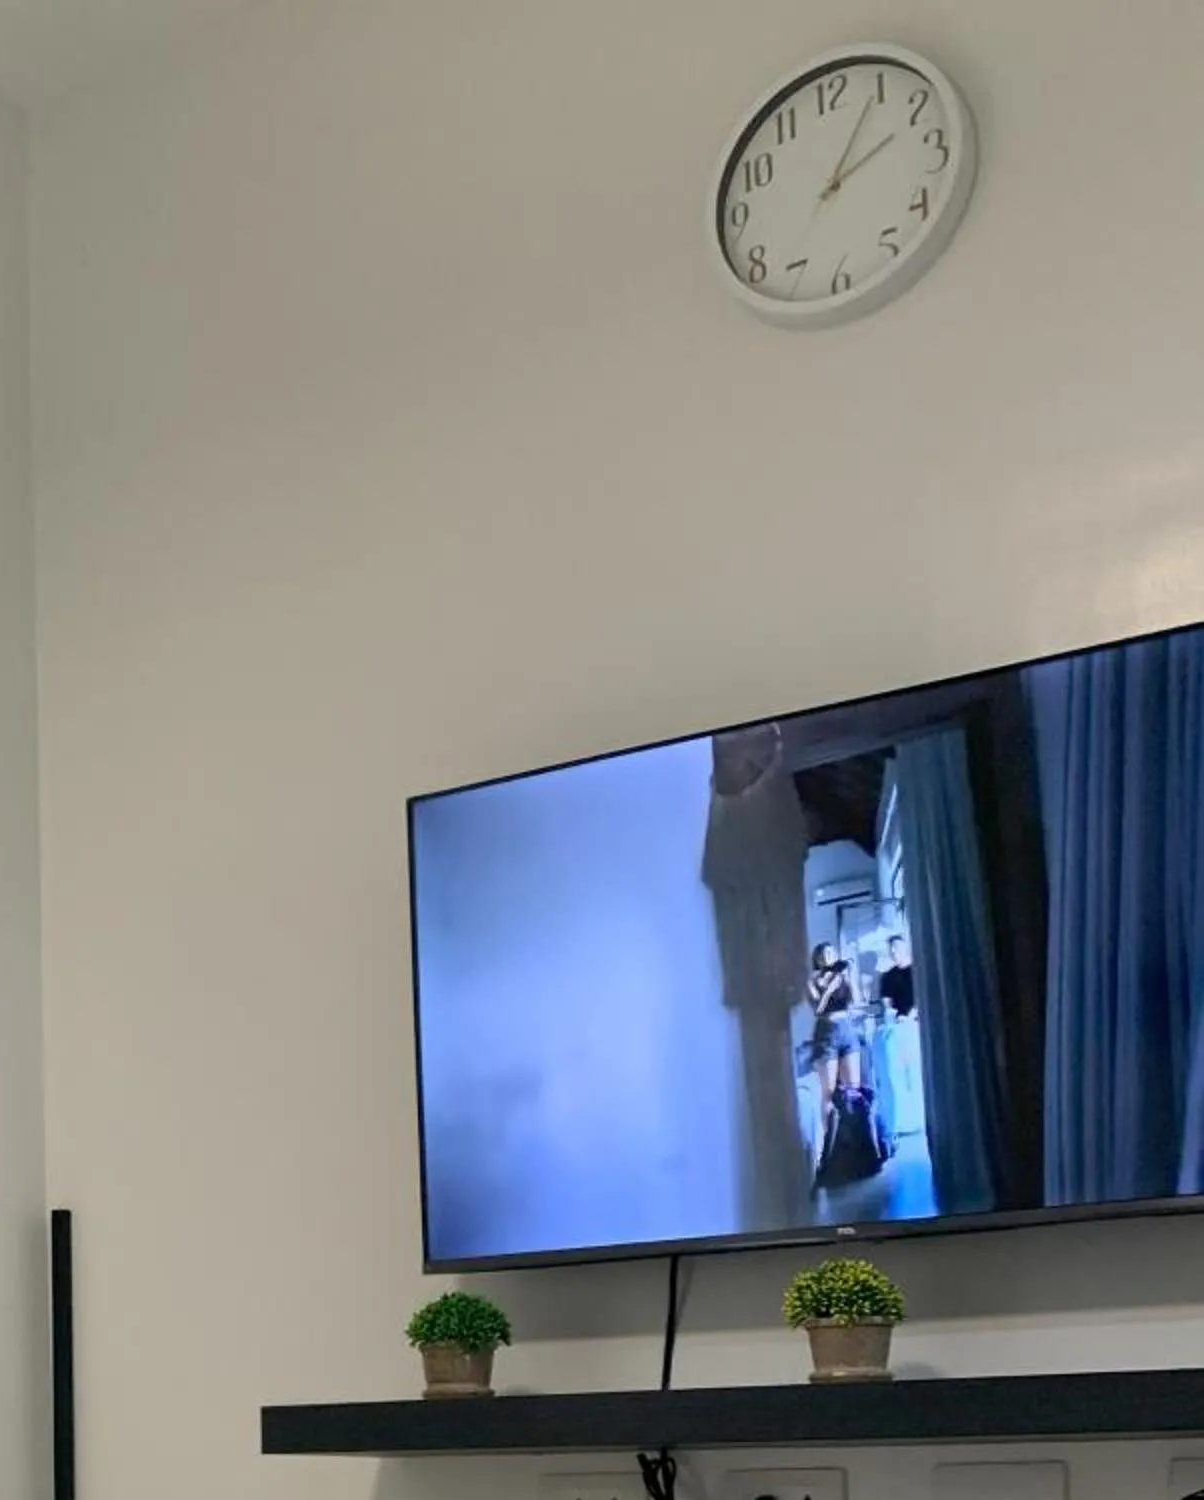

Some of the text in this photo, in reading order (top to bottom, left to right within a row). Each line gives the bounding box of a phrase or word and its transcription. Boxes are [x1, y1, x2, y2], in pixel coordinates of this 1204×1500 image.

[815, 73, 847, 116] 12
[876, 71, 885, 104] 1
[908, 88, 930, 127] 2
[775, 106, 797, 145] 11
[923, 128, 950, 174] 3
[743, 152, 774, 194] 10
[731, 201, 750, 241] 9
[908, 187, 930, 222] 4
[877, 226, 901, 258] 5
[747, 244, 768, 285] 8
[785, 257, 809, 298] 7
[830, 251, 852, 296] 6
